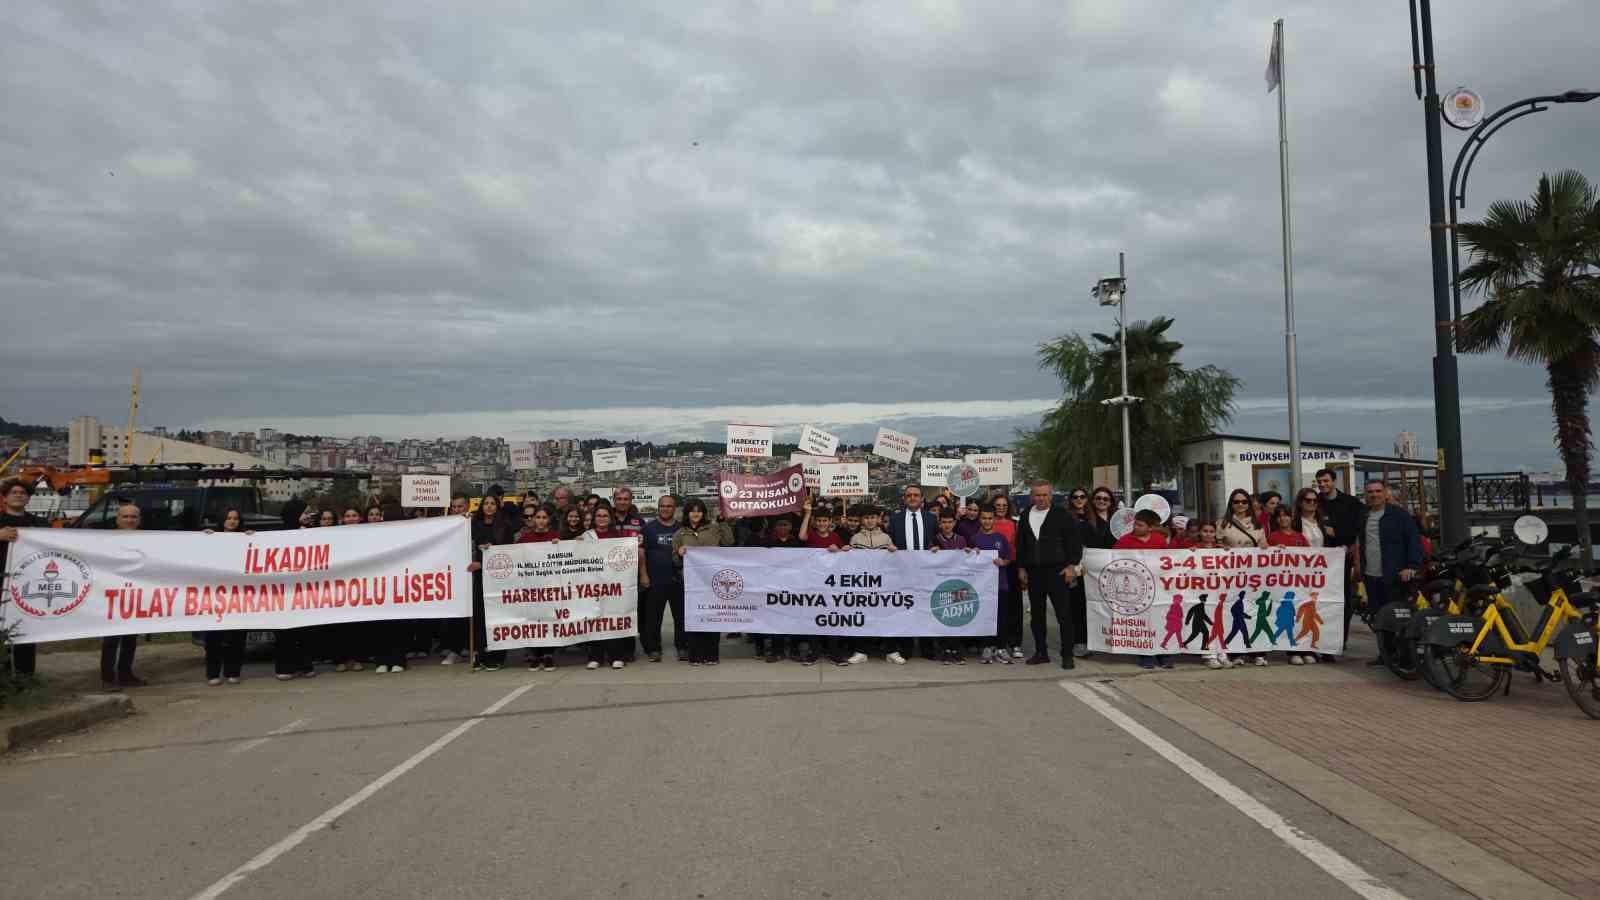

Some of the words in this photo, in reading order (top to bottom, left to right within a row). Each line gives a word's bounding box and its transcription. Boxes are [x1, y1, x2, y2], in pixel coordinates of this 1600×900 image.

[1240, 452, 1290, 462] BÜYÜKŞEH
[1302, 451, 1336, 460] ZABITA
[738, 490, 753, 499] 23
[756, 486, 788, 498] NİSAN
[730, 496, 797, 510] ORTAOKULU
[244, 542, 330, 574] İLKADIM
[547, 552, 573, 560] SAMSUN
[1160, 556, 1198, 570] 3-4
[1202, 552, 1252, 570] EKİM
[1257, 551, 1328, 569] DÜNYA
[824, 574, 836, 588] 4
[840, 572, 882, 588] EKİM
[1160, 574, 1262, 592] YÜRÜYÜŞ
[1266, 572, 1326, 588] GÜNÜ
[105, 582, 180, 620] TÜLAY
[184, 584, 286, 622] BAŞARAN
[291, 578, 386, 612] ANADOLU
[393, 565, 453, 604] LİSESİ
[502, 582, 572, 604] HAREKETLİ
[576, 583, 622, 602] YAŞAM
[766, 590, 826, 607] DÜNYA
[831, 590, 914, 609] YÜRÜYÜŞ
[556, 608, 570, 619] ve
[815, 612, 865, 628] GÜNÜ
[493, 620, 548, 642] SPORTİF
[553, 616, 632, 638] FAALİYETLER
[1111, 618, 1146, 627] SAMSUN
[1129, 628, 1156, 638] EĞİTİM
